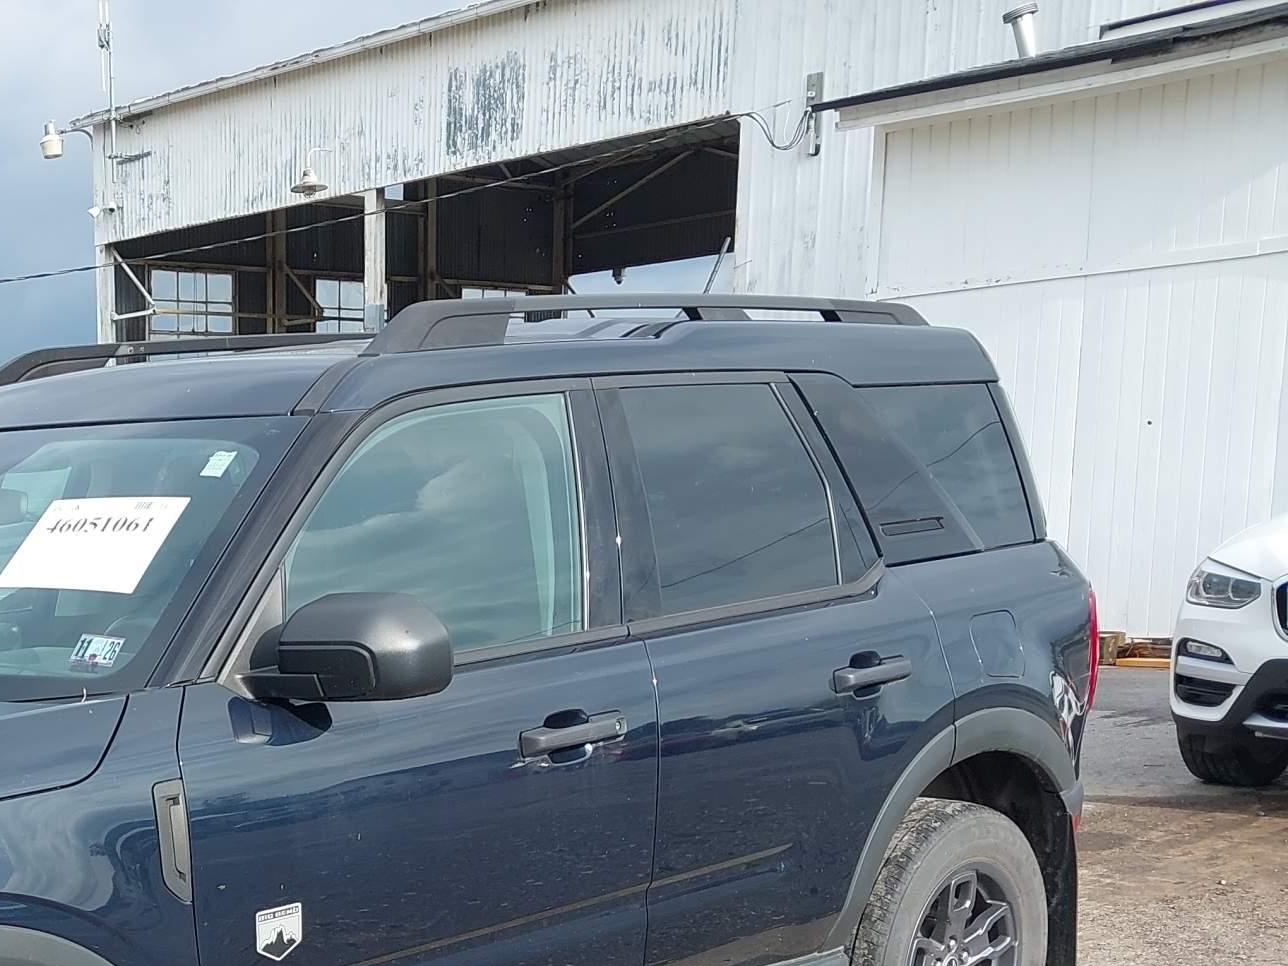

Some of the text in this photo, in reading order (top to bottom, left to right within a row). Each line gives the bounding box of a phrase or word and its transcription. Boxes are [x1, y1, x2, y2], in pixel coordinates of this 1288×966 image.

[45, 516, 155, 534] 46051061
[74, 638, 121, 660] 11 26
